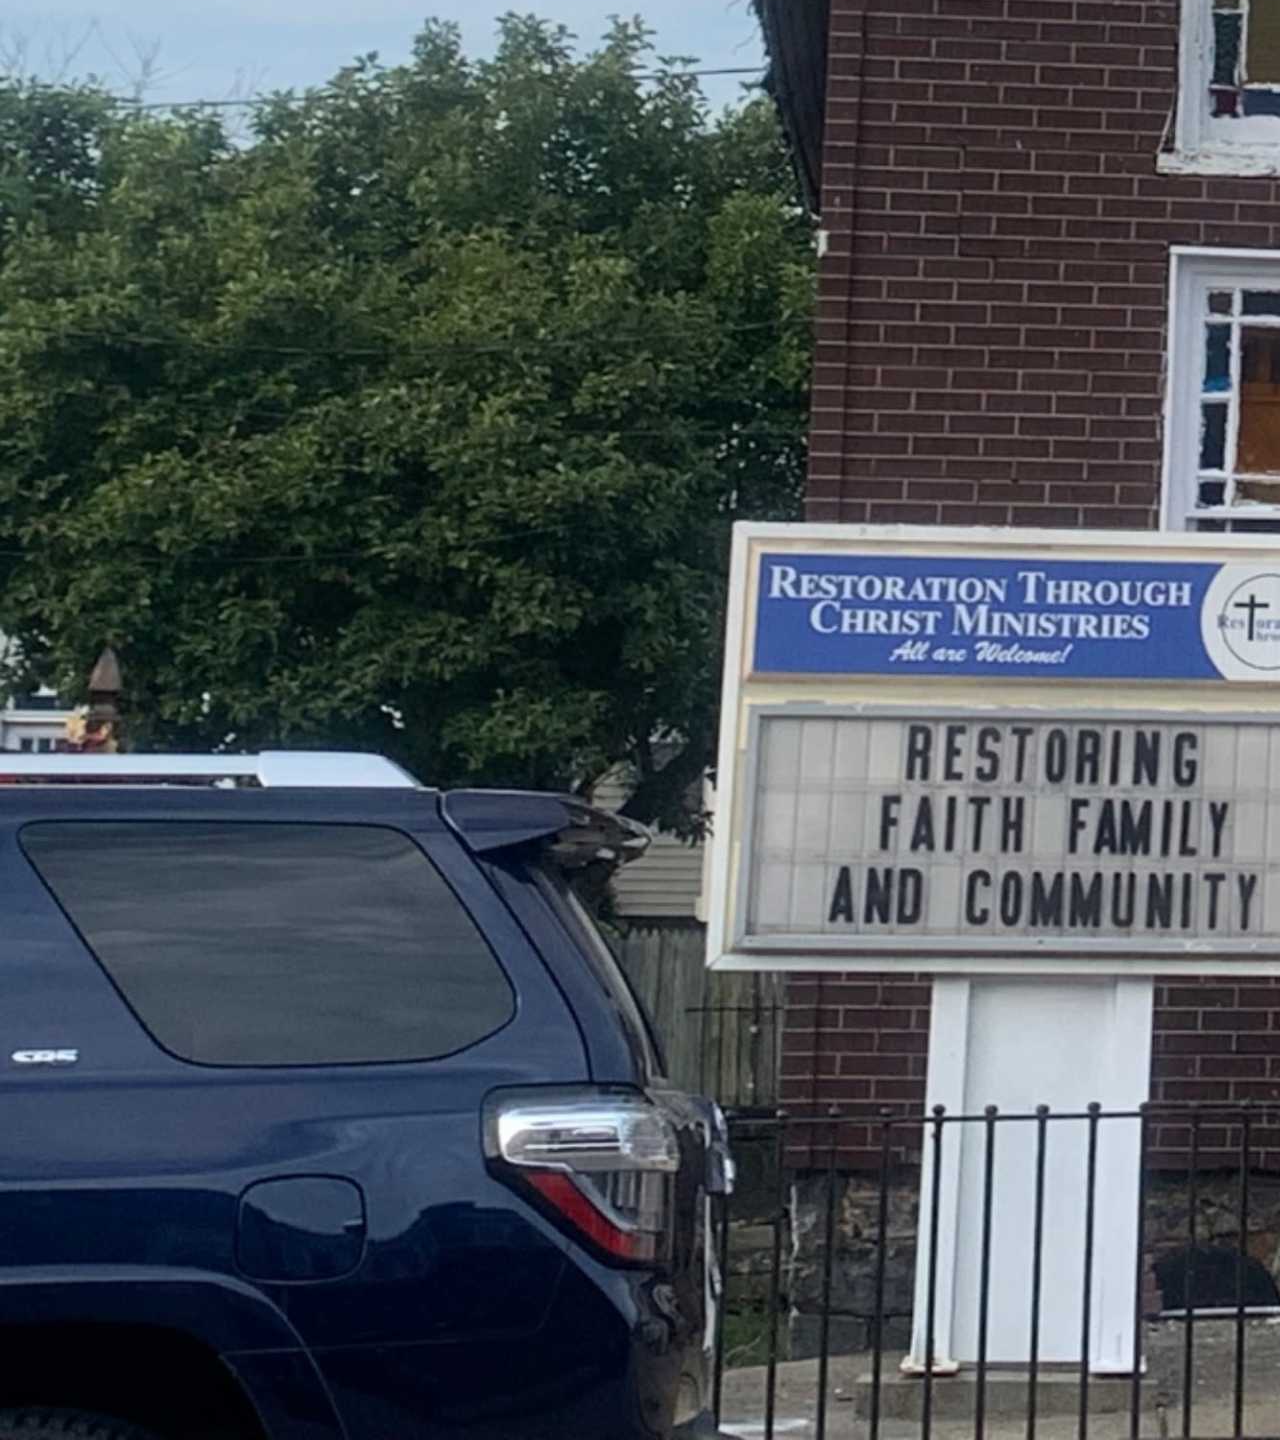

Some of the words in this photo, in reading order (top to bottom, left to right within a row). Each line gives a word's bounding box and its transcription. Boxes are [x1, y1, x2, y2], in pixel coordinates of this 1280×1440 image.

[888, 640, 931, 662] All
[931, 647, 967, 662] are
[973, 641, 1074, 664] Welcome!
[906, 724, 1199, 787] RESTORING
[879, 794, 1024, 853] FAITH
[1068, 798, 1229, 858] FAMILY
[828, 865, 924, 925] AND
[964, 868, 1257, 931] COMMUNITY
